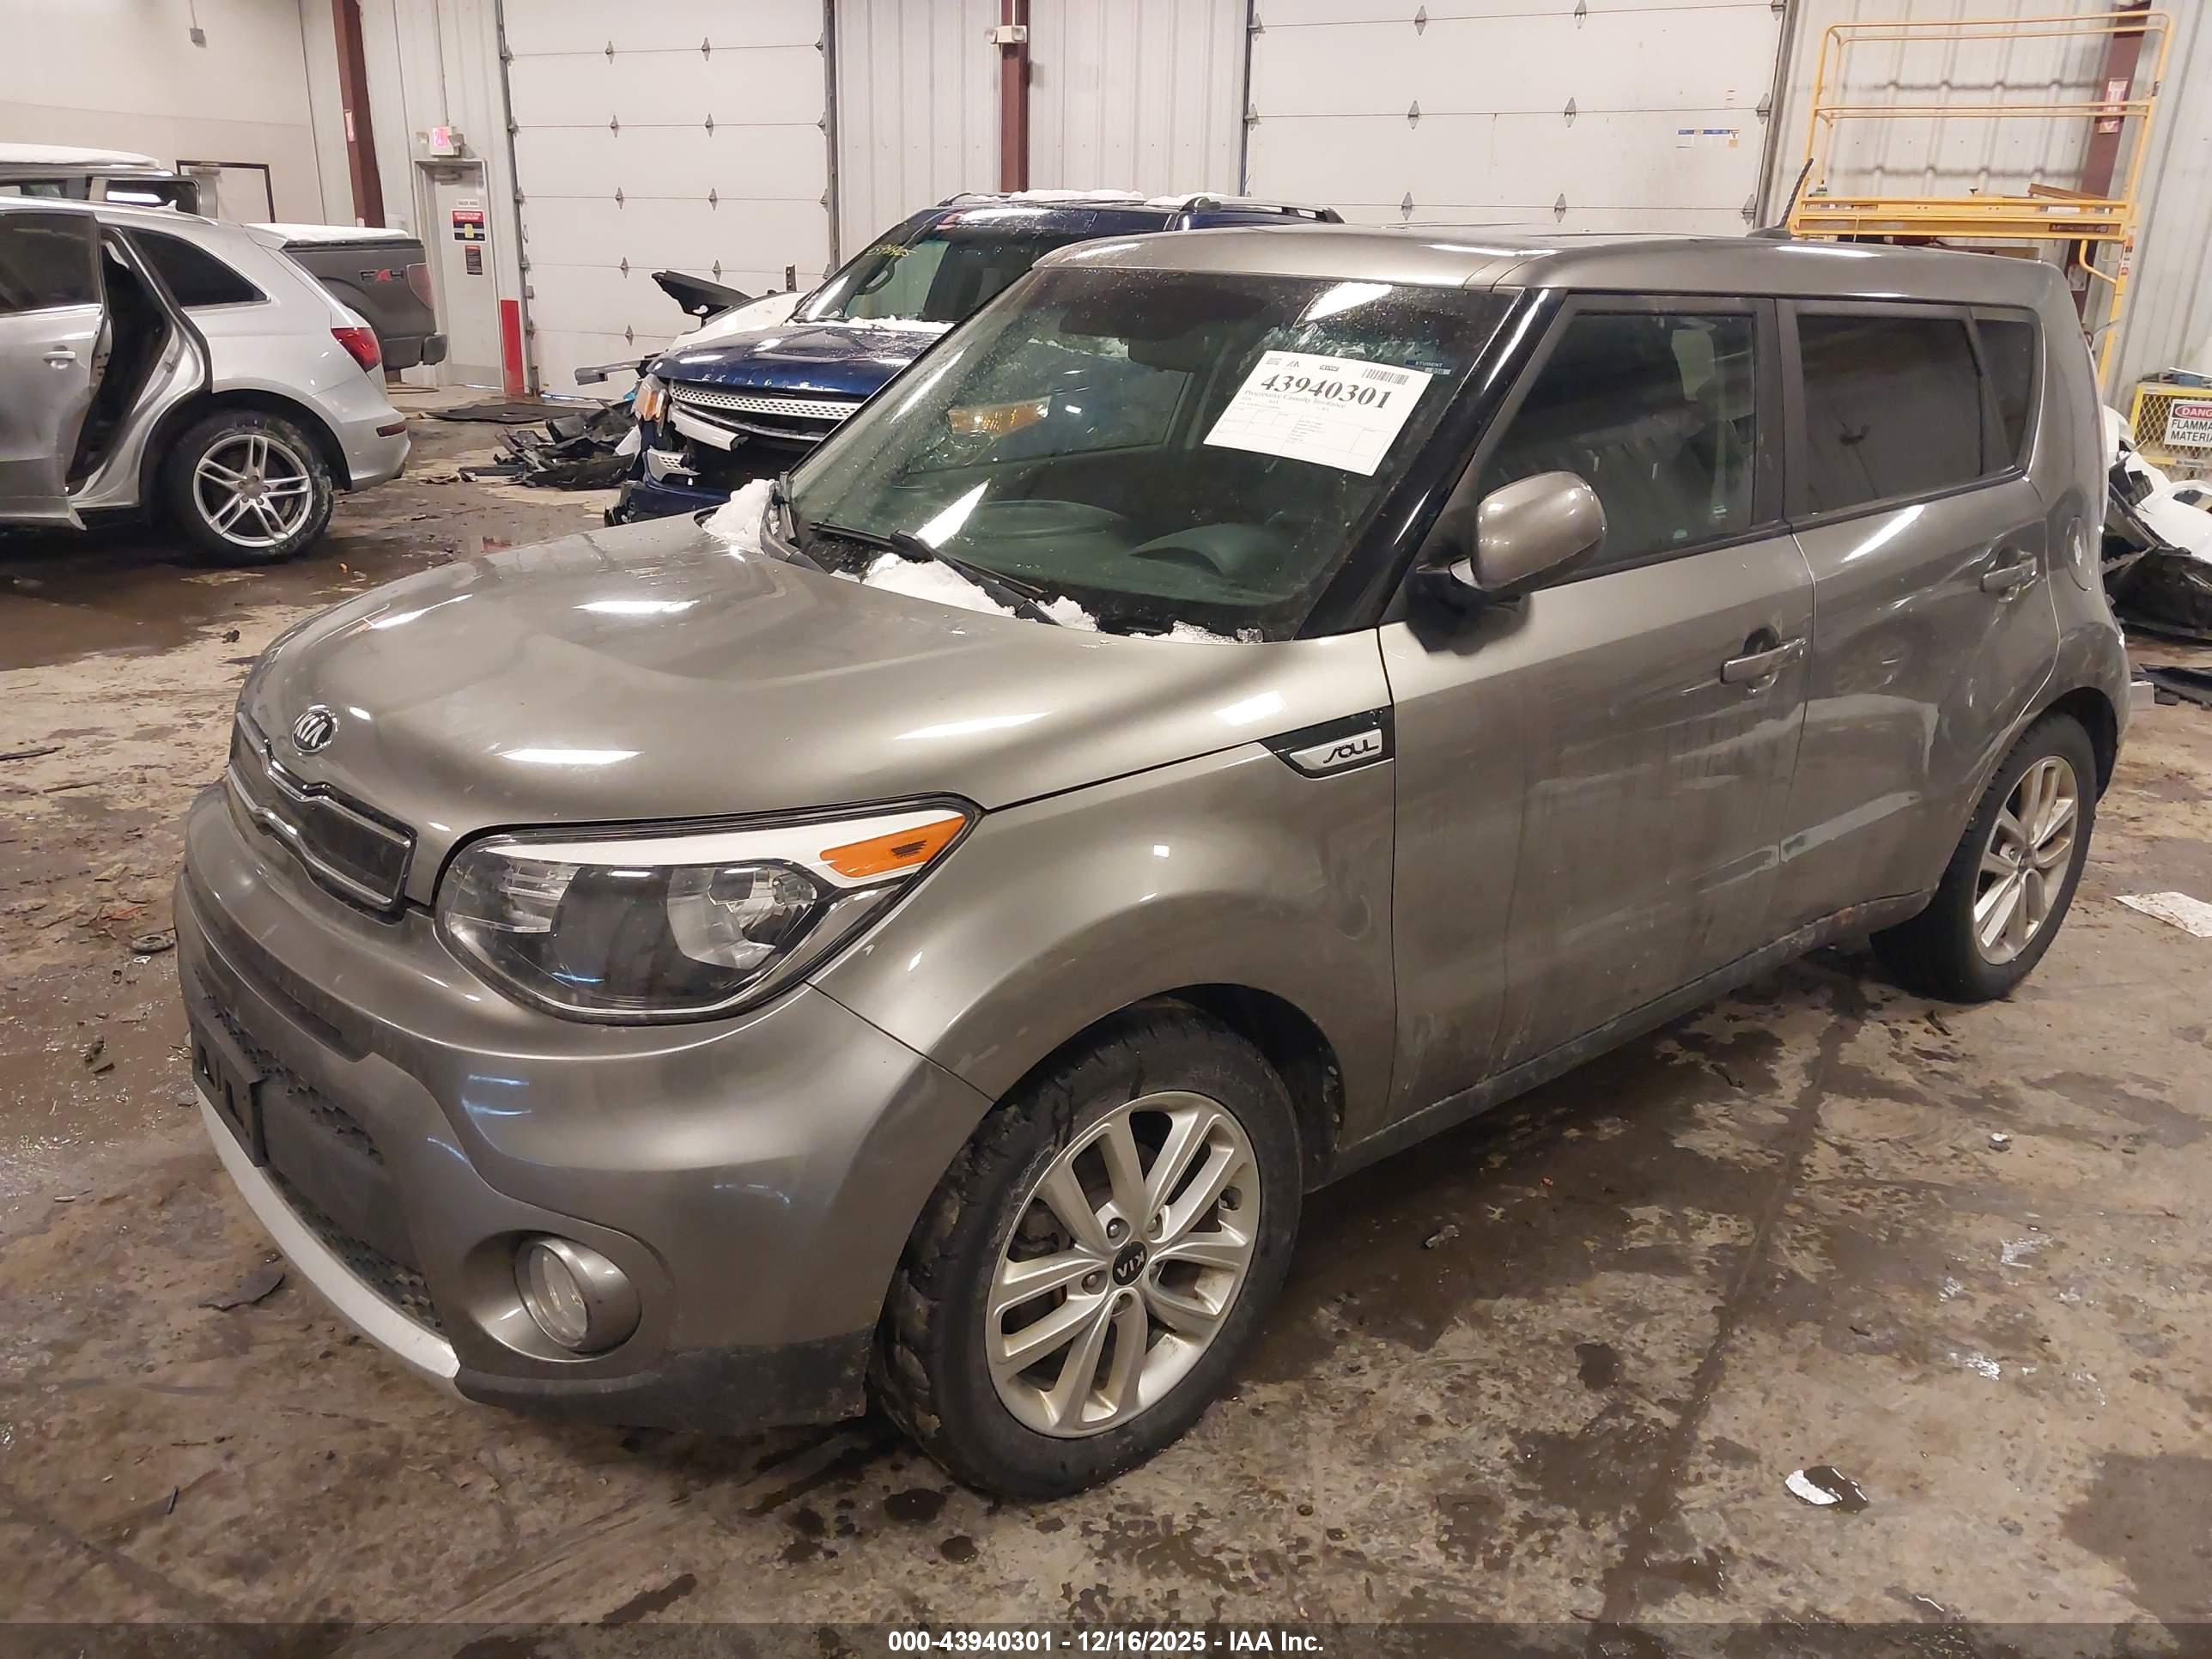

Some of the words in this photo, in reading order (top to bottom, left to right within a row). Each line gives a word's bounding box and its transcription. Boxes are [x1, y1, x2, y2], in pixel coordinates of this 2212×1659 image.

[1261, 374, 1392, 410] 43940301
[2172, 419, 2212, 430] FLAMMA
[1323, 739, 1379, 763] SOUL
